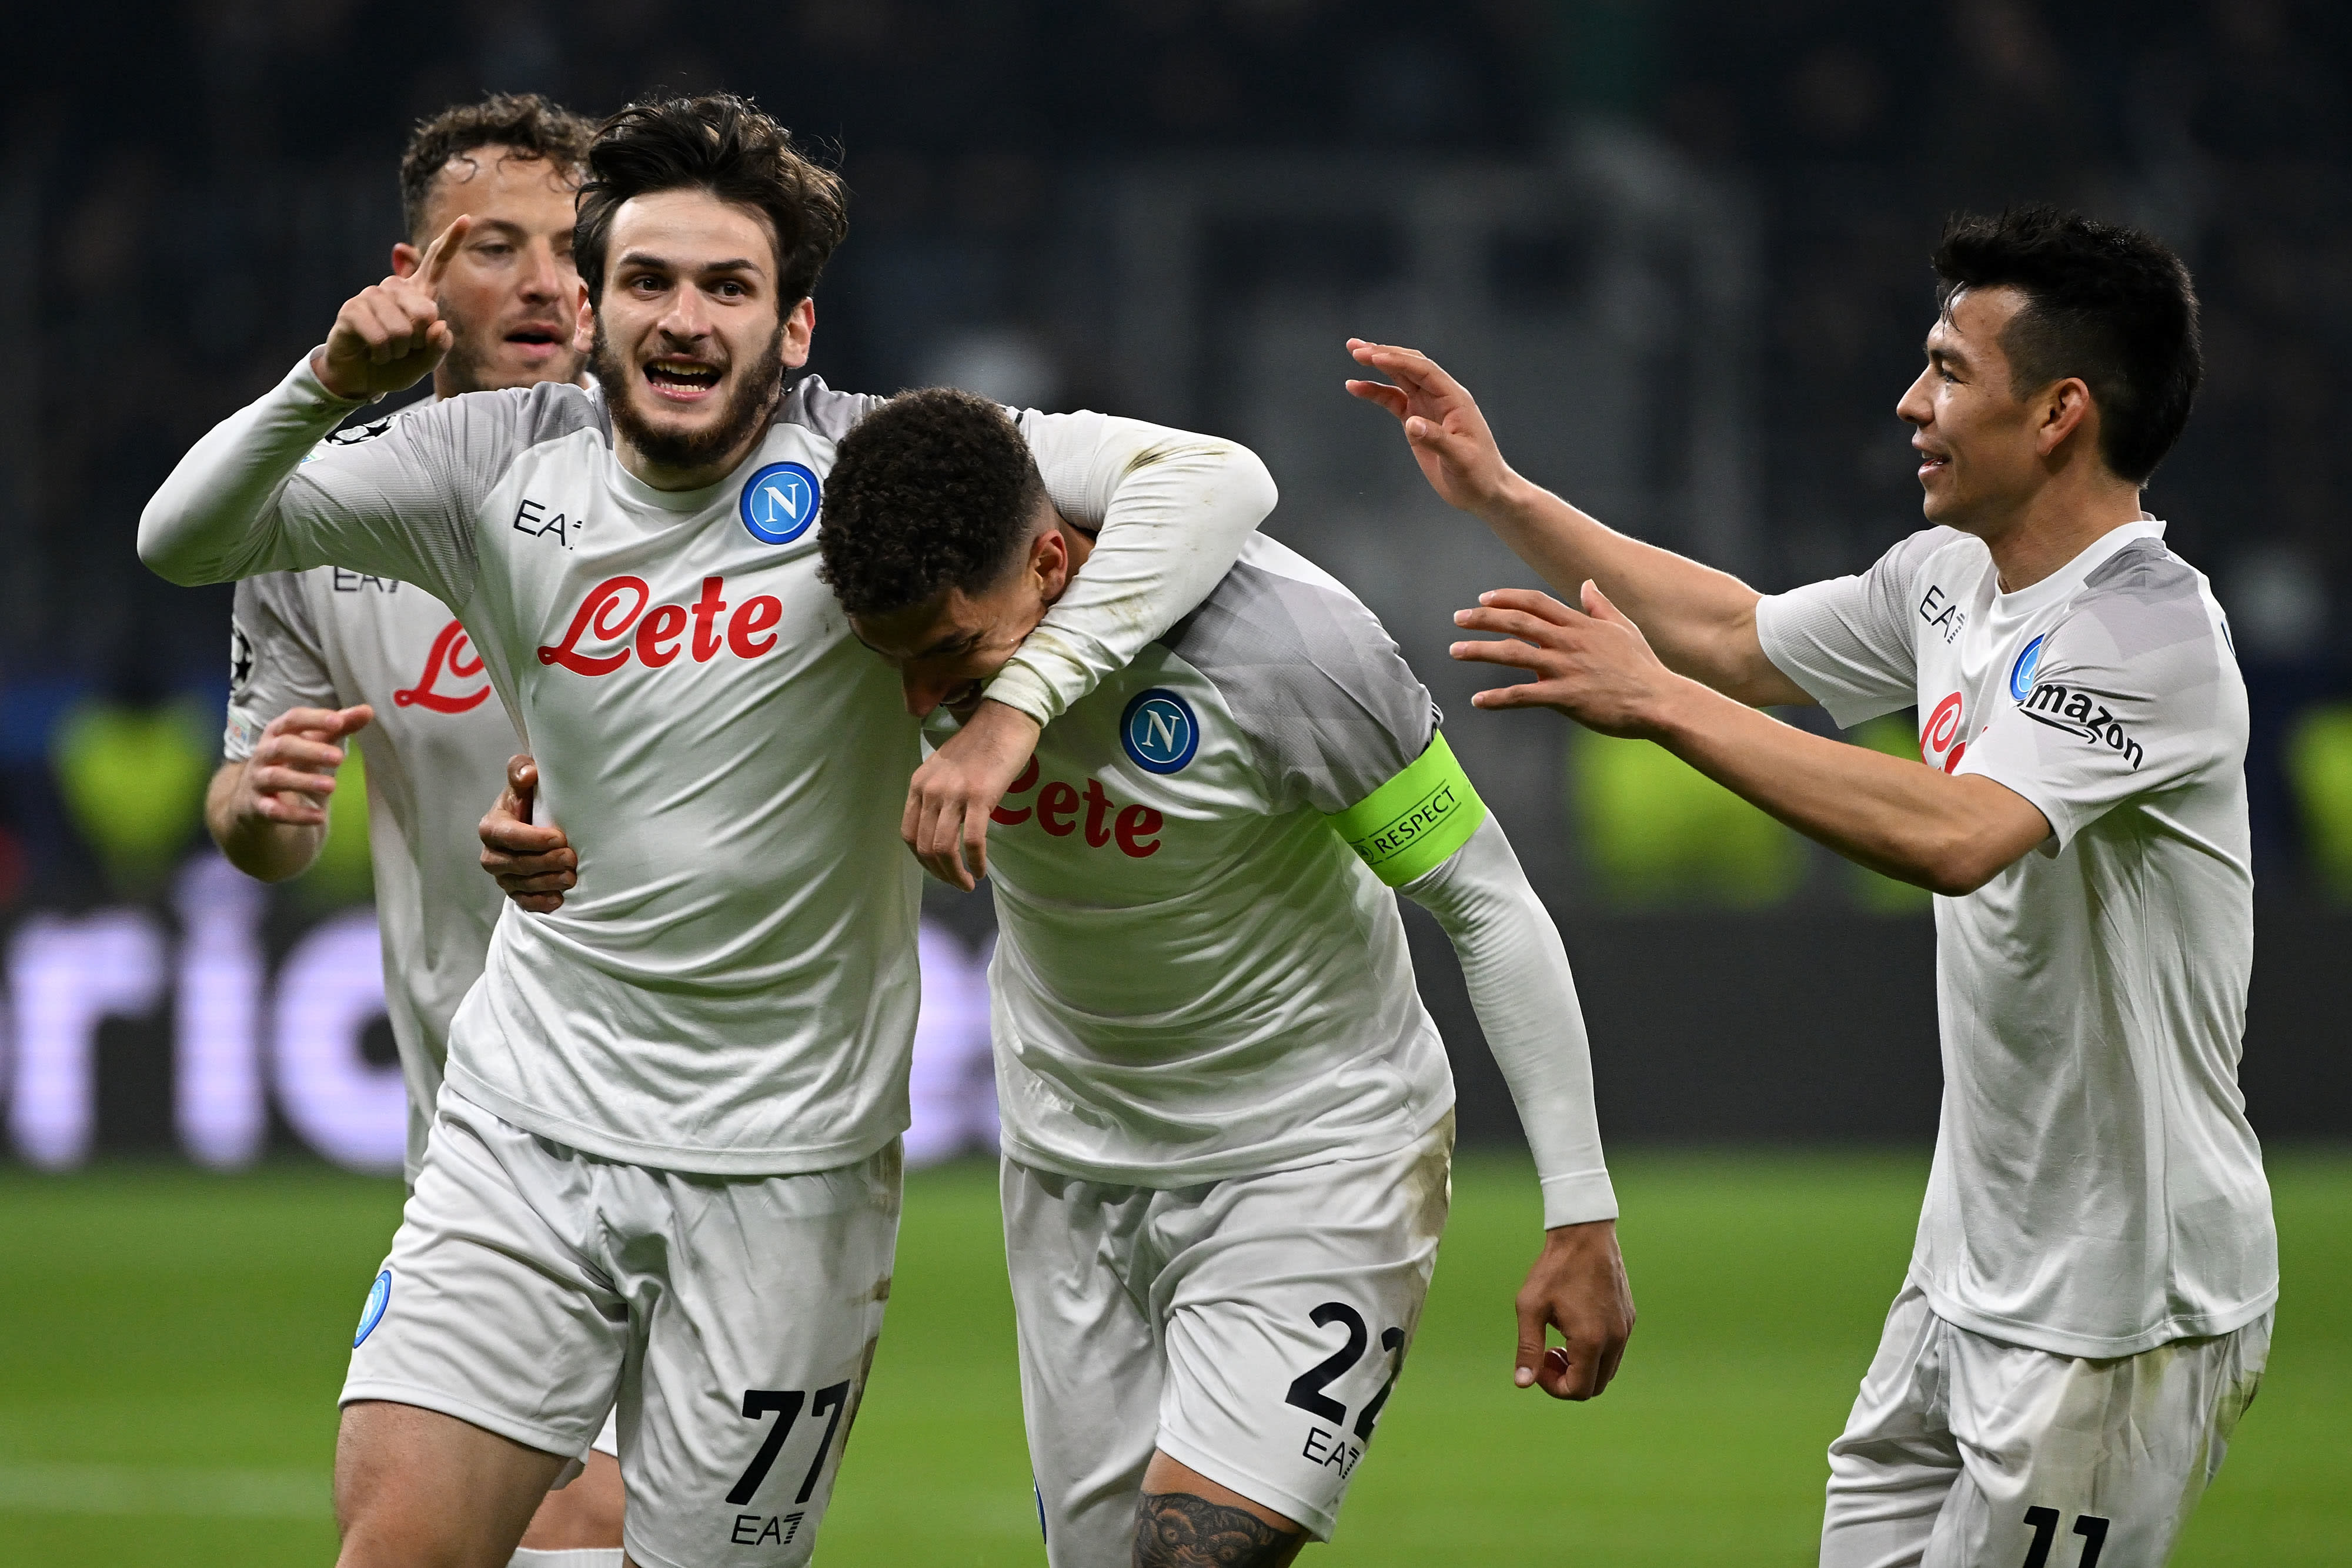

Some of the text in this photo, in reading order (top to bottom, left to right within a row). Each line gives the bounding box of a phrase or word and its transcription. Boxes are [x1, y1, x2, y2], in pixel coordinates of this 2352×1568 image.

[763, 483, 800, 523] N
[537, 576, 783, 677] Lete
[1141, 709, 1180, 753] N
[2017, 684, 2143, 771] mazon
[1374, 785, 1455, 853] RESPECT
[725, 1379, 850, 1506] 77
[731, 1512, 805, 1546] EA7
